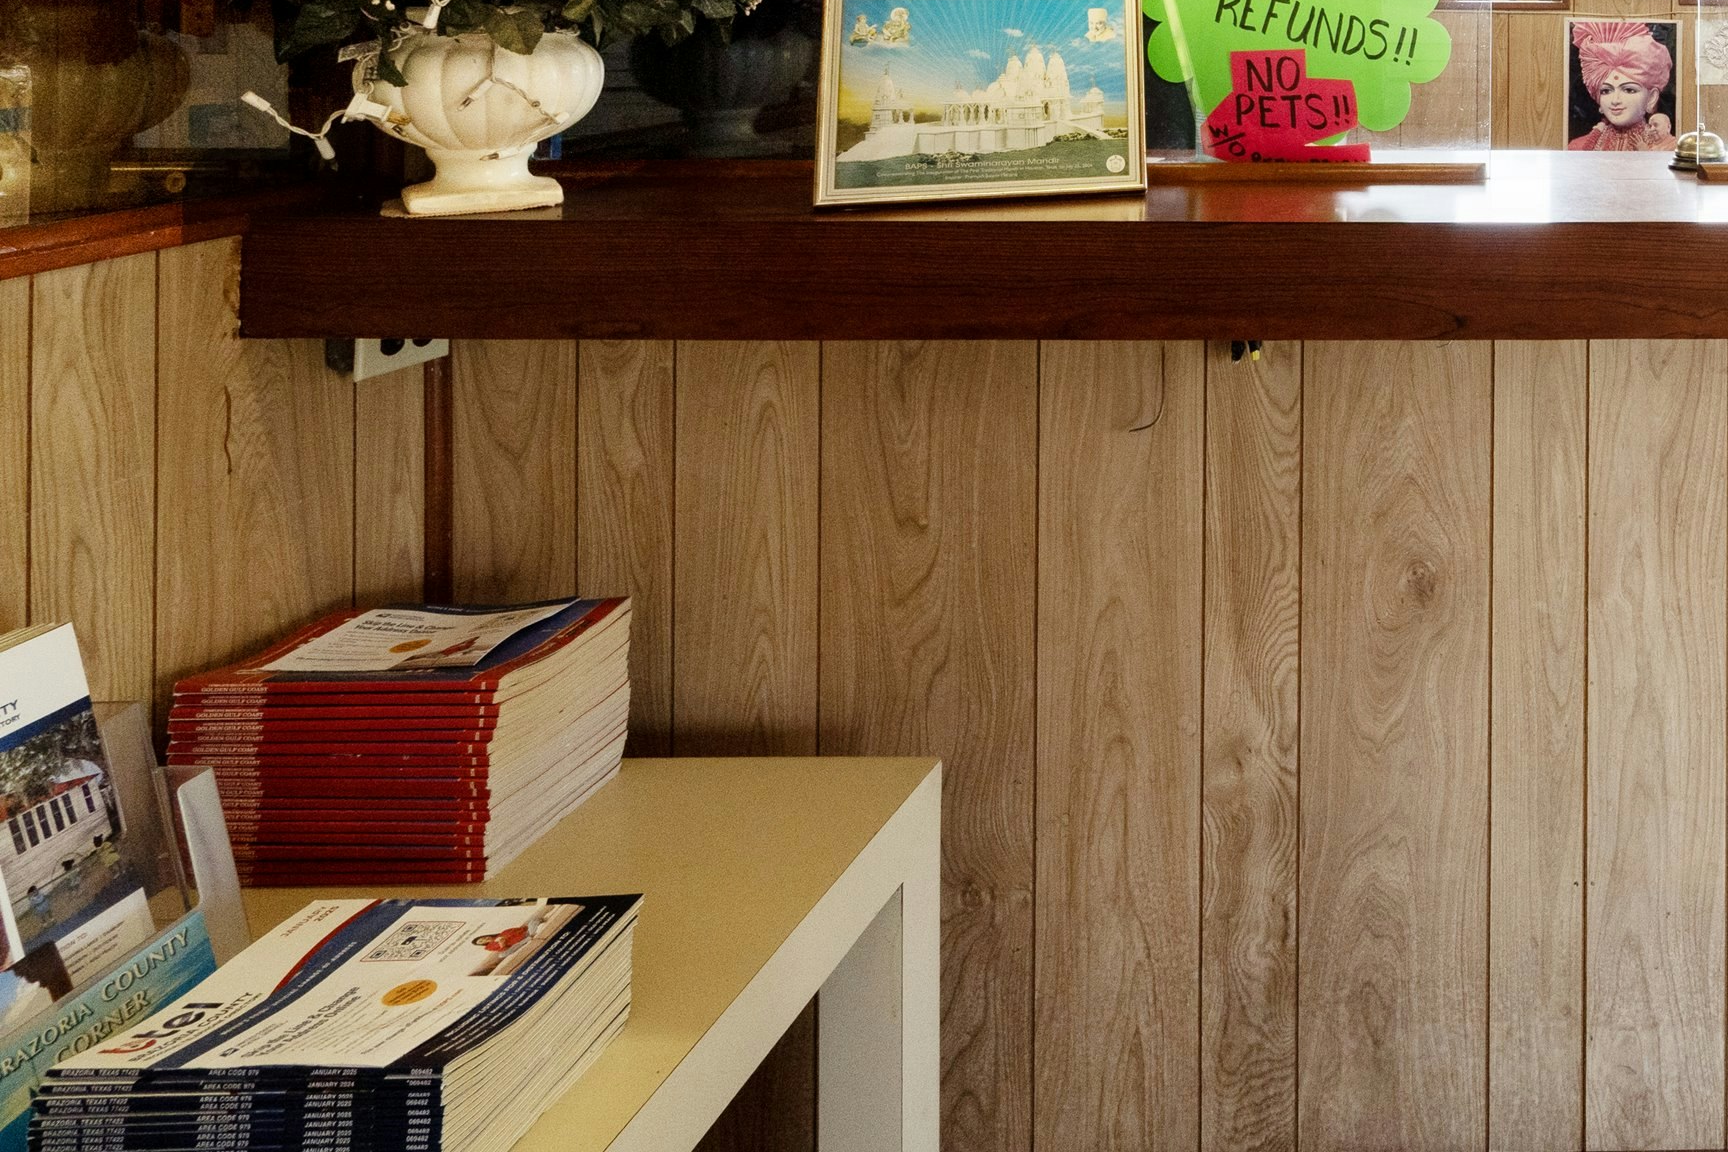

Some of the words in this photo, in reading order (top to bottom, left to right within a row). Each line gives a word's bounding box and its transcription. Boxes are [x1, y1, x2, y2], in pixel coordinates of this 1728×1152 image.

[1246, 57, 1300, 92] NO
[1236, 93, 1350, 130] PETS!!
[0, 1002, 95, 1079] RAZORIA
[101, 927, 189, 1002] COUNTY
